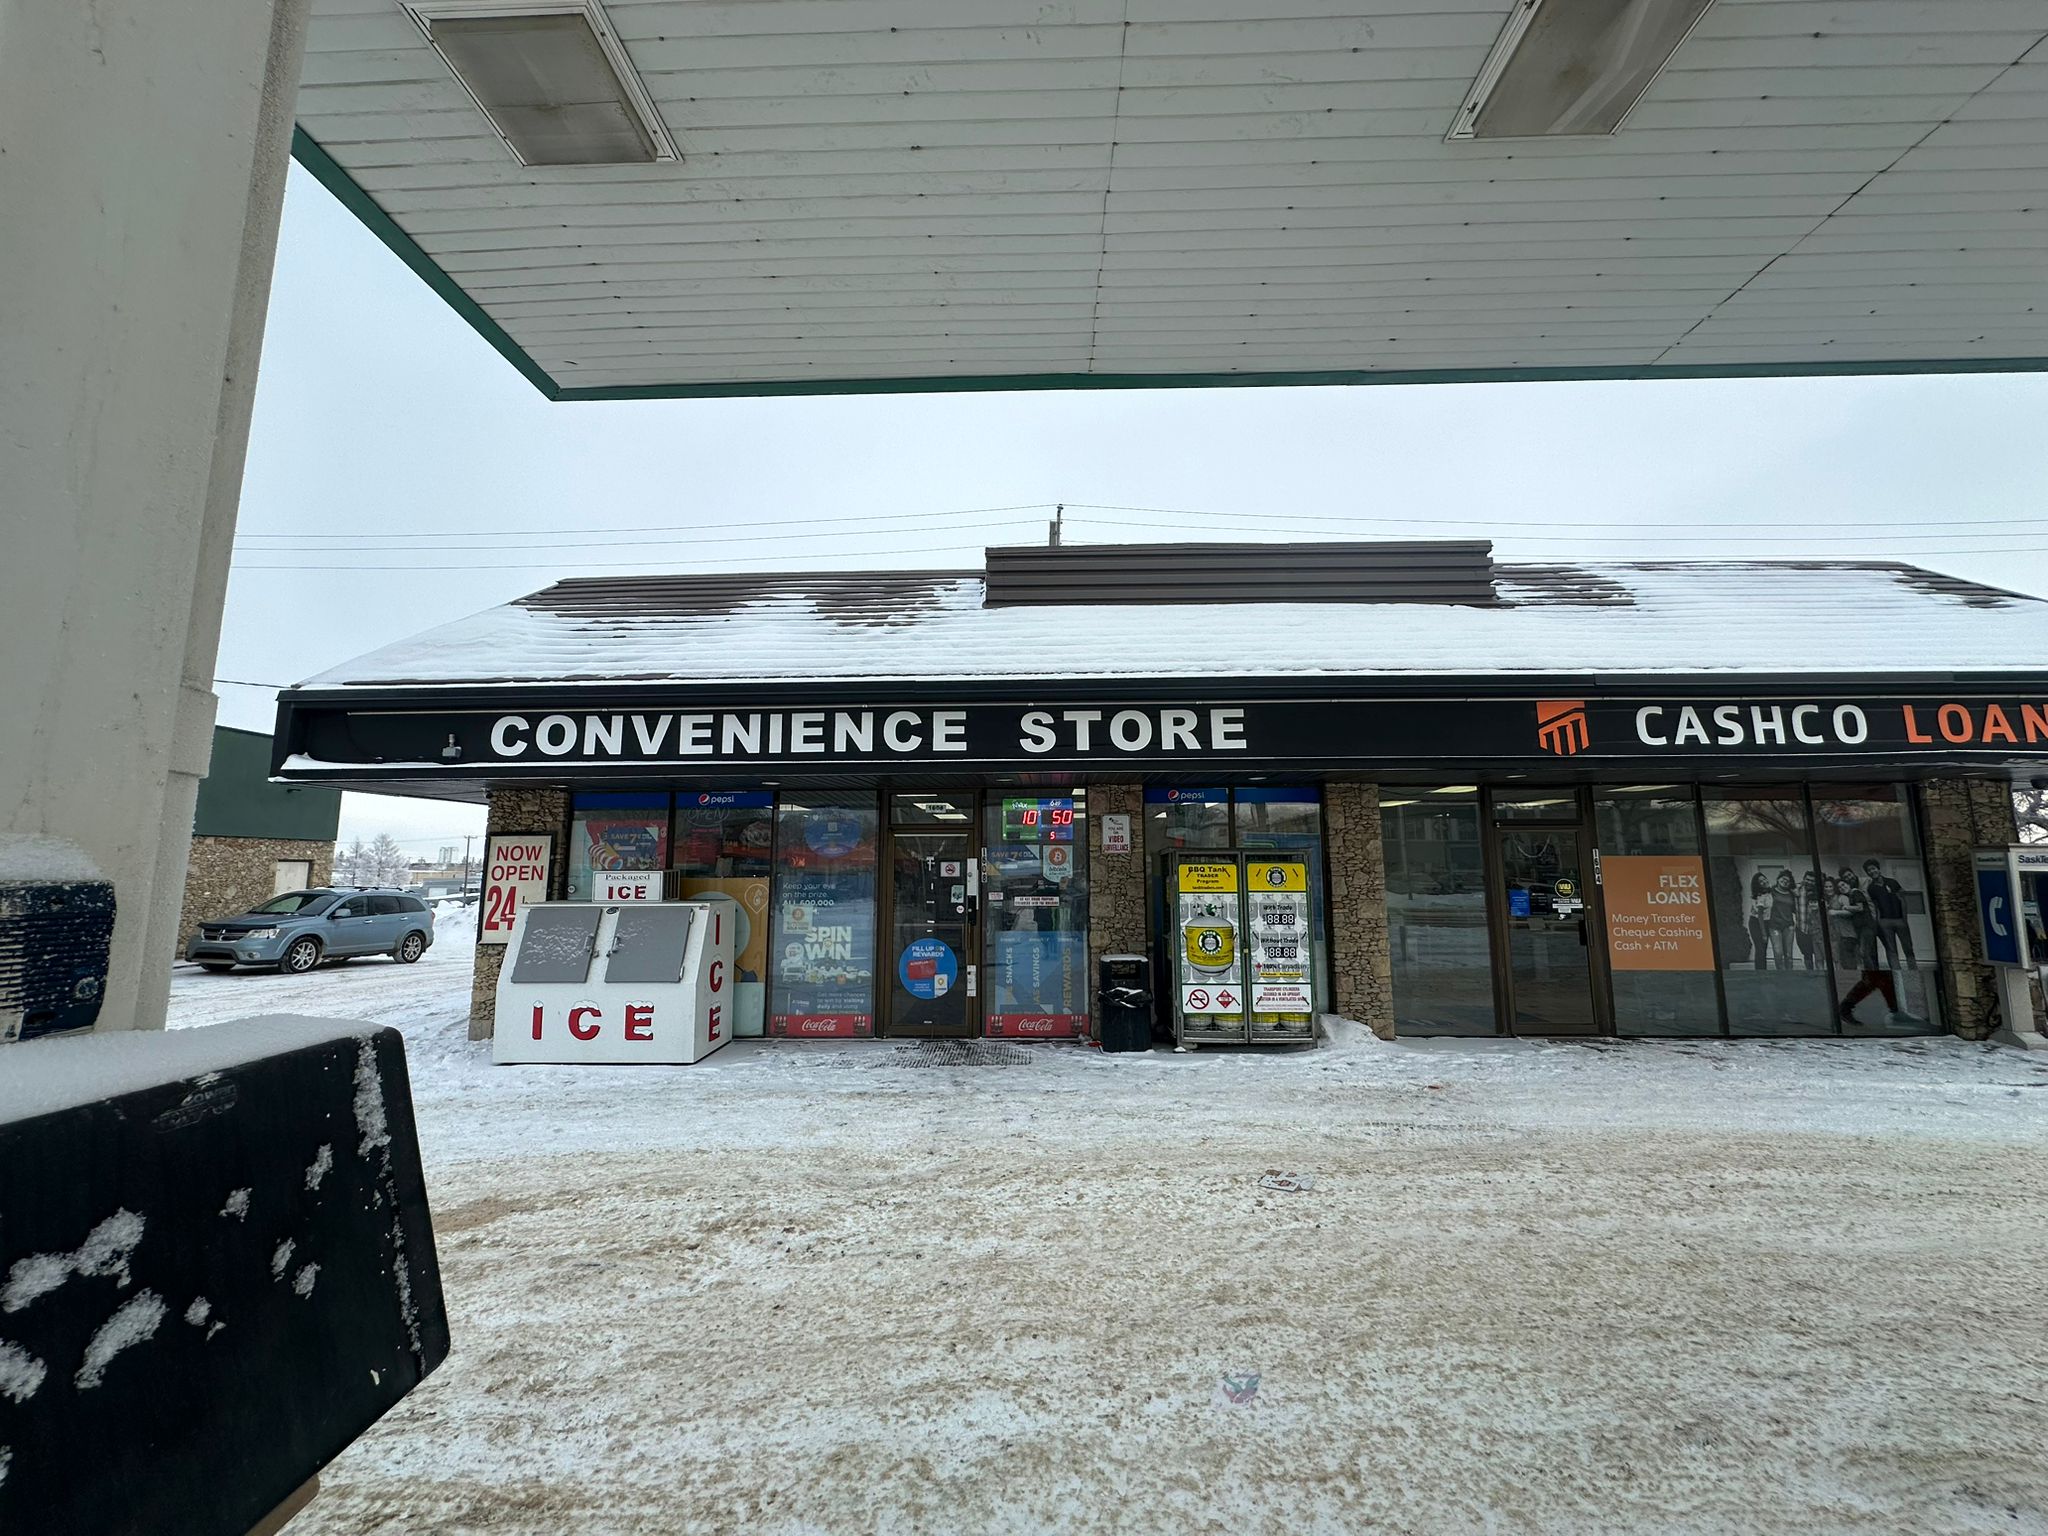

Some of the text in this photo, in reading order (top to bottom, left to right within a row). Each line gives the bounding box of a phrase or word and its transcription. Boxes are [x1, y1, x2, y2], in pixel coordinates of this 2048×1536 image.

[490, 707, 1248, 757] CONVENIENCE STORE
[1636, 704, 1869, 747] CASHCO
[1903, 703, 2048, 745] LOAN
[711, 794, 735, 804] pepsi
[1180, 791, 1205, 801] pepsi
[1022, 810, 1073, 825] 10 50
[1108, 835, 1124, 843] VIDEO
[496, 845, 543, 861] NOW
[491, 865, 545, 882] OPEN
[604, 873, 651, 882] Packaged
[1659, 875, 1699, 888] FLEX
[607, 885, 647, 900] ICE
[783, 882, 802, 890] Keep
[803, 883, 820, 891] your
[1647, 892, 1701, 905] LOANS
[484, 885, 517, 931] 24
[1611, 913, 1696, 925] Money Transfer
[804, 926, 852, 943] SPIN
[1612, 927, 1703, 940] Cheque Cashing
[803, 943, 852, 960] WIN
[1614, 941, 1642, 951] Cash
[1653, 941, 1679, 951] ATM
[1005, 947, 1013, 985] SNACKS
[1032, 946, 1041, 988] SAVINGS
[708, 911, 724, 1041] ICE
[1062, 947, 1072, 1008] REWARDS
[531, 1000, 655, 1041] ICE
